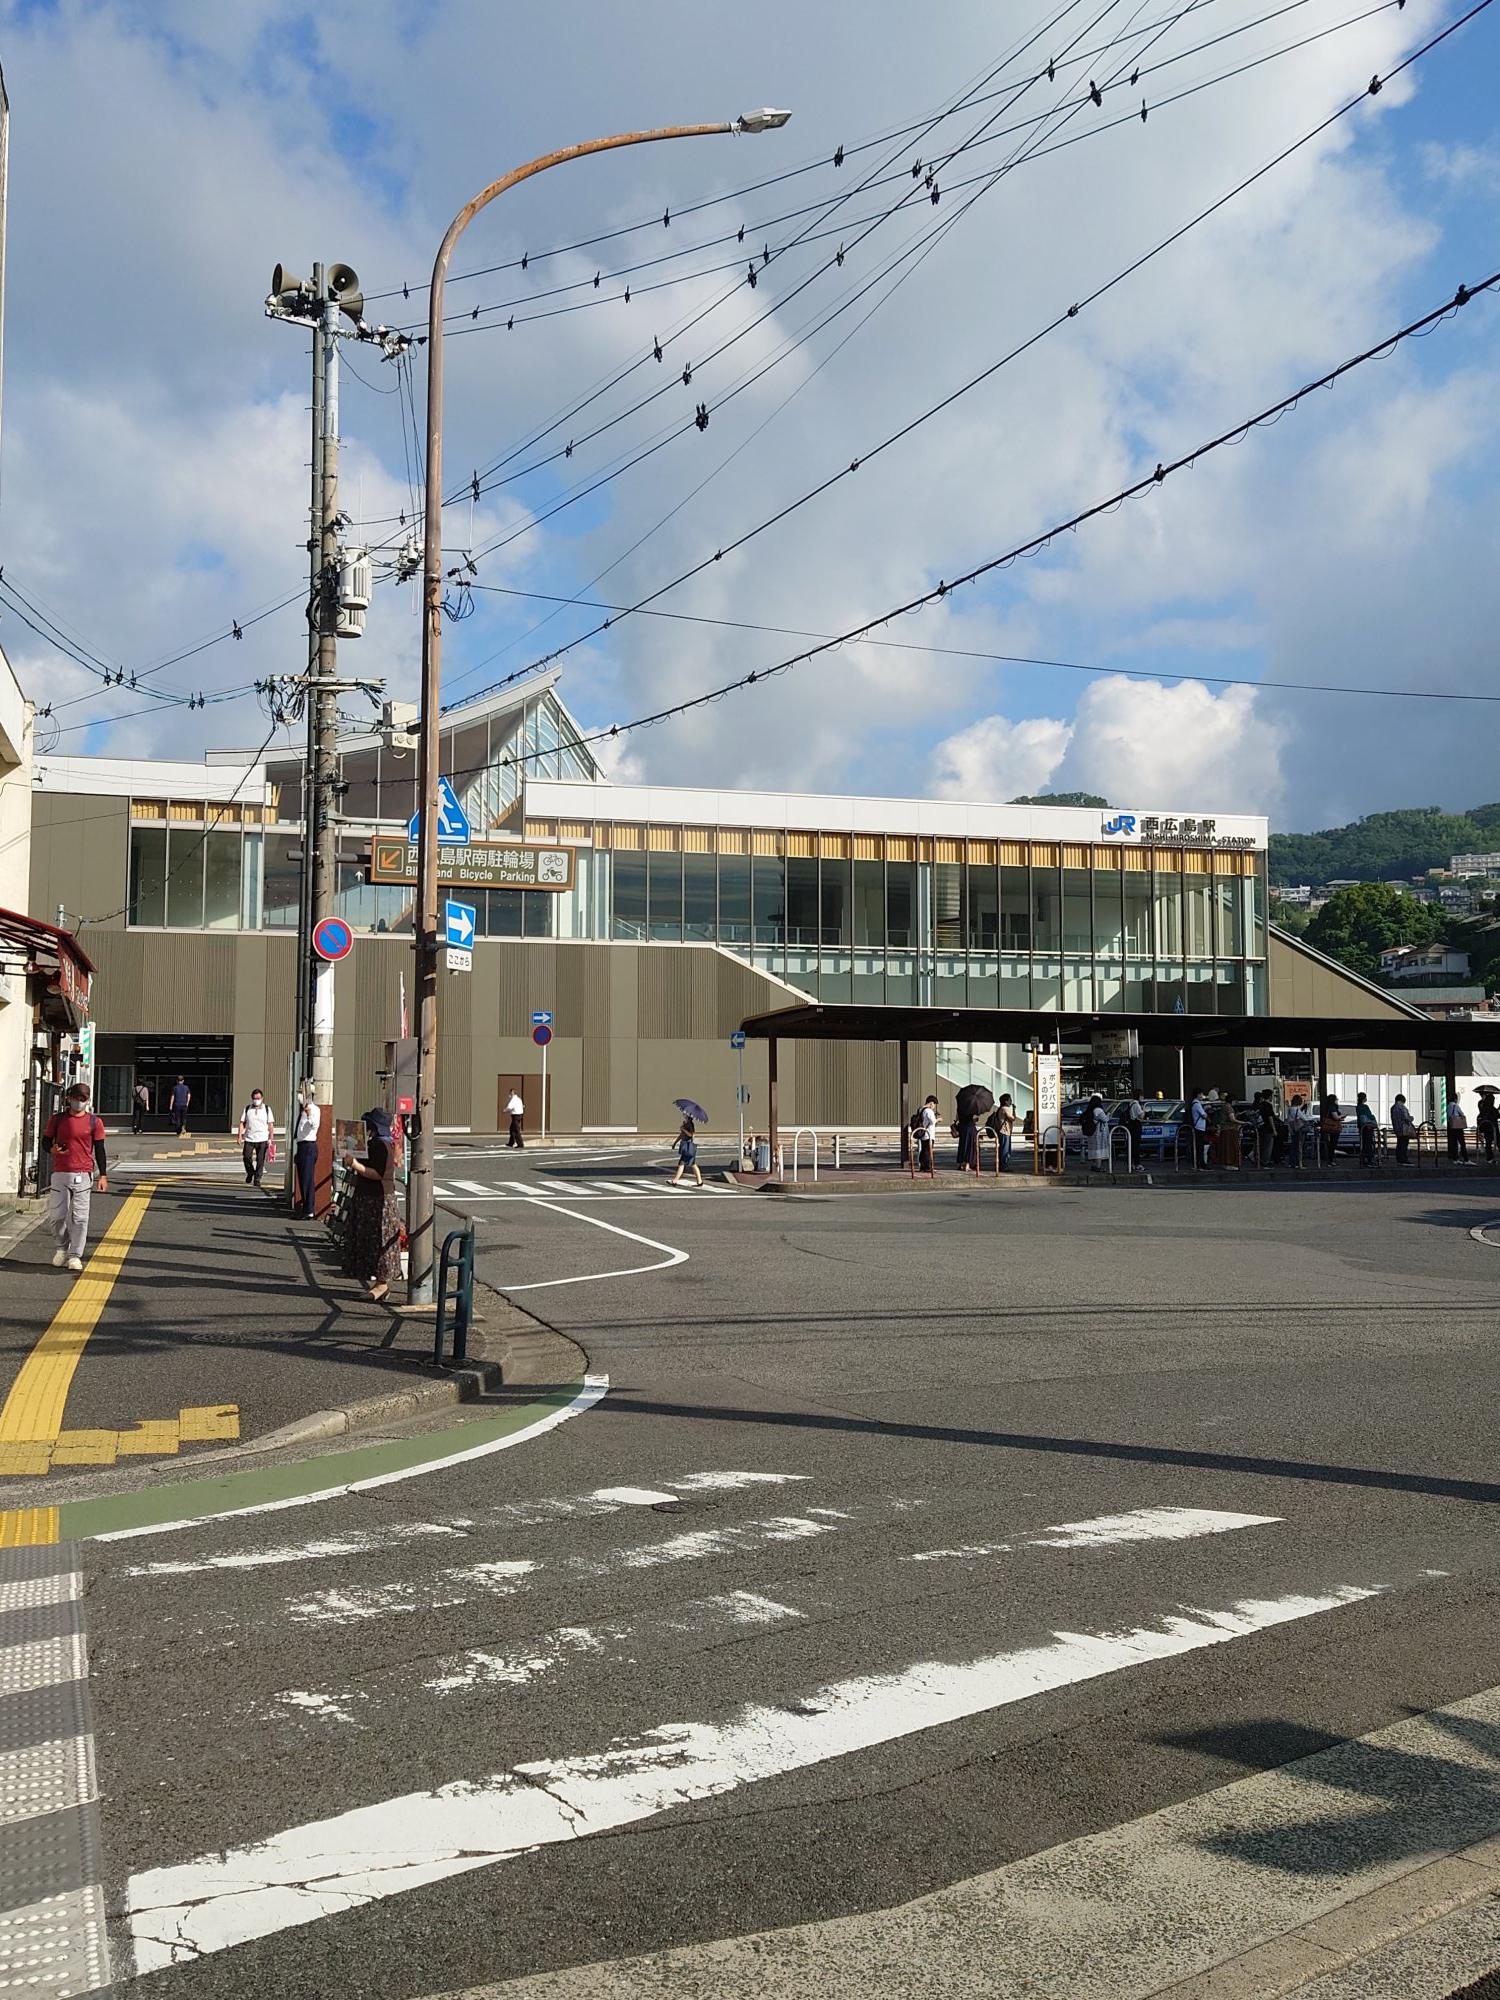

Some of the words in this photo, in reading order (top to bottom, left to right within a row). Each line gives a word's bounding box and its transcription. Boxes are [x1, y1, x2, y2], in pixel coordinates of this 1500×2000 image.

[1107, 815, 1136, 832] JR
[1145, 816, 1216, 833] 西広島駅
[1222, 836, 1256, 845] STATION
[407, 845, 535, 870] 西島駅南駐輪場
[460, 868, 493, 882] Bicycle
[500, 870, 535, 884] Parking
[448, 954, 470, 967] ここから
